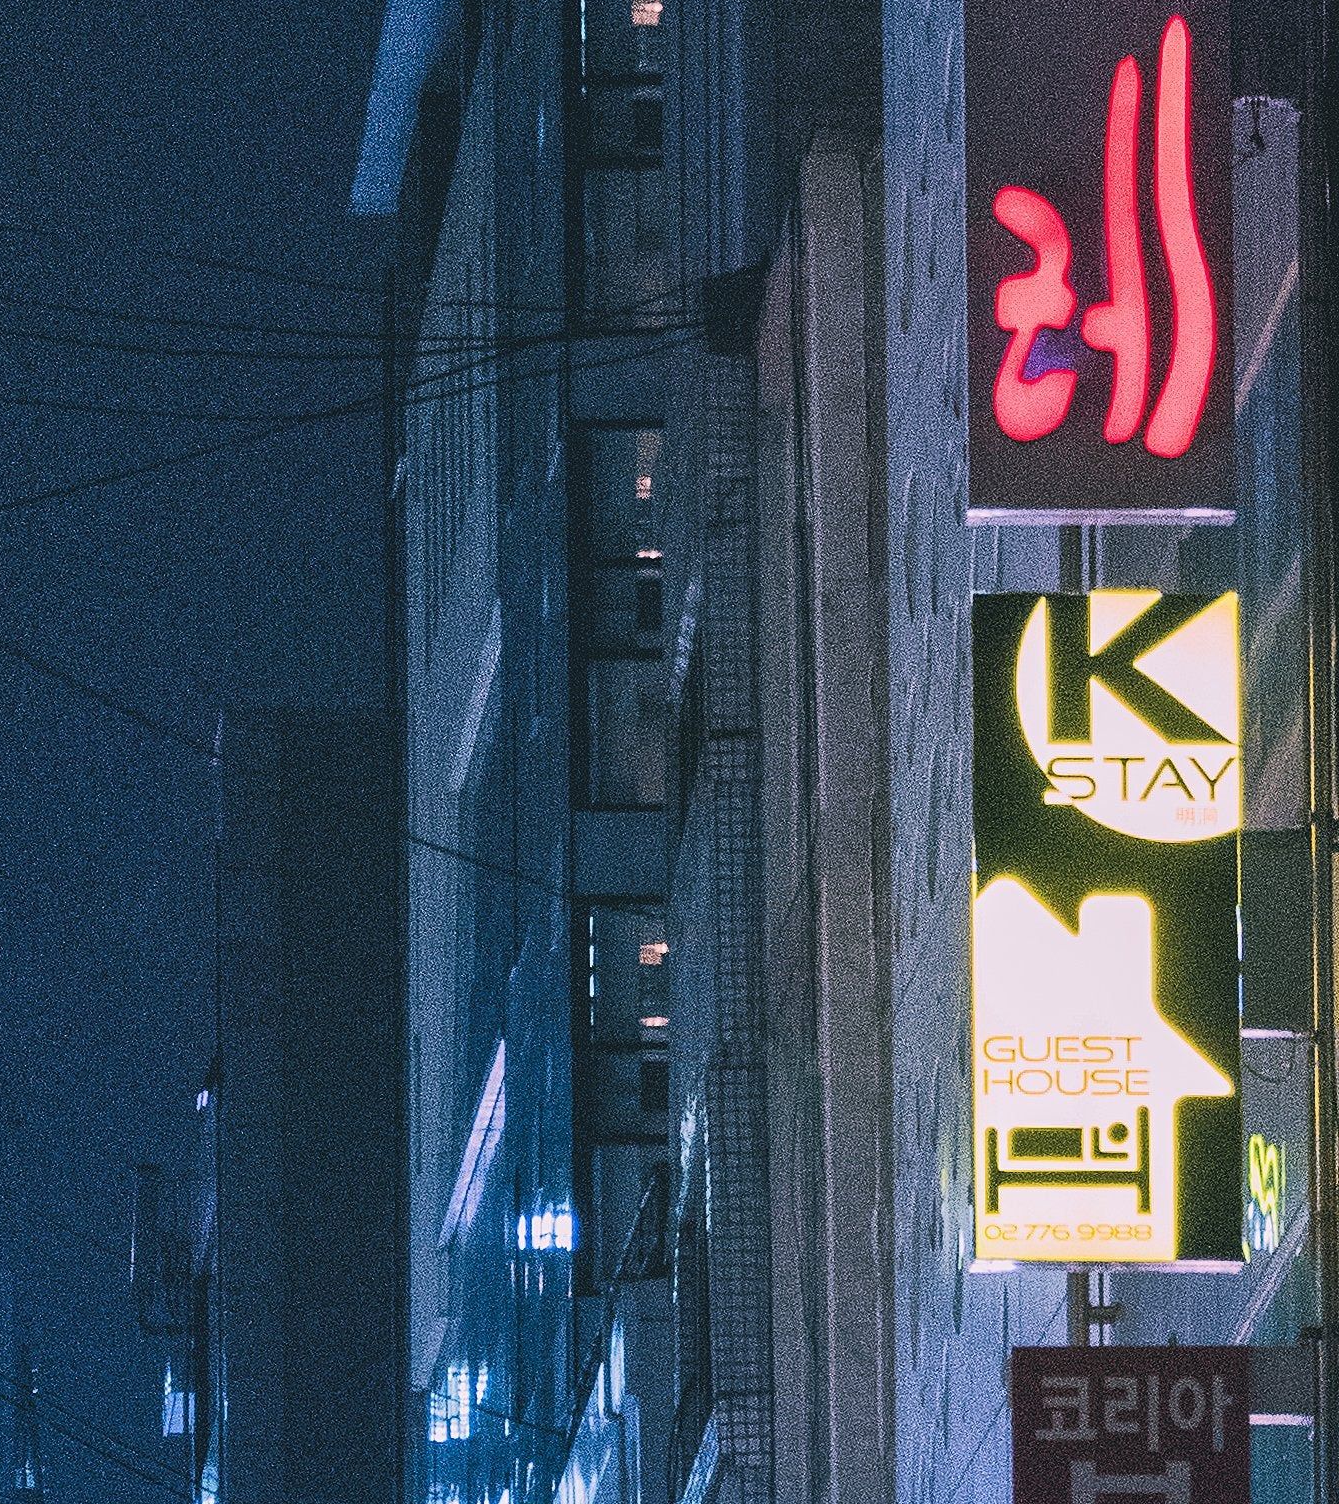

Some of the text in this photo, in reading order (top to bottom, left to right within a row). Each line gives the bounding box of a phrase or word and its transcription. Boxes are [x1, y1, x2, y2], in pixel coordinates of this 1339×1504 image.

[1045, 590, 1238, 745] K
[1044, 756, 1236, 803] STAY
[983, 1035, 1143, 1063] GUEST
[983, 1069, 1150, 1096] HOUSE
[1035, 1374, 1233, 1453] 코리아
